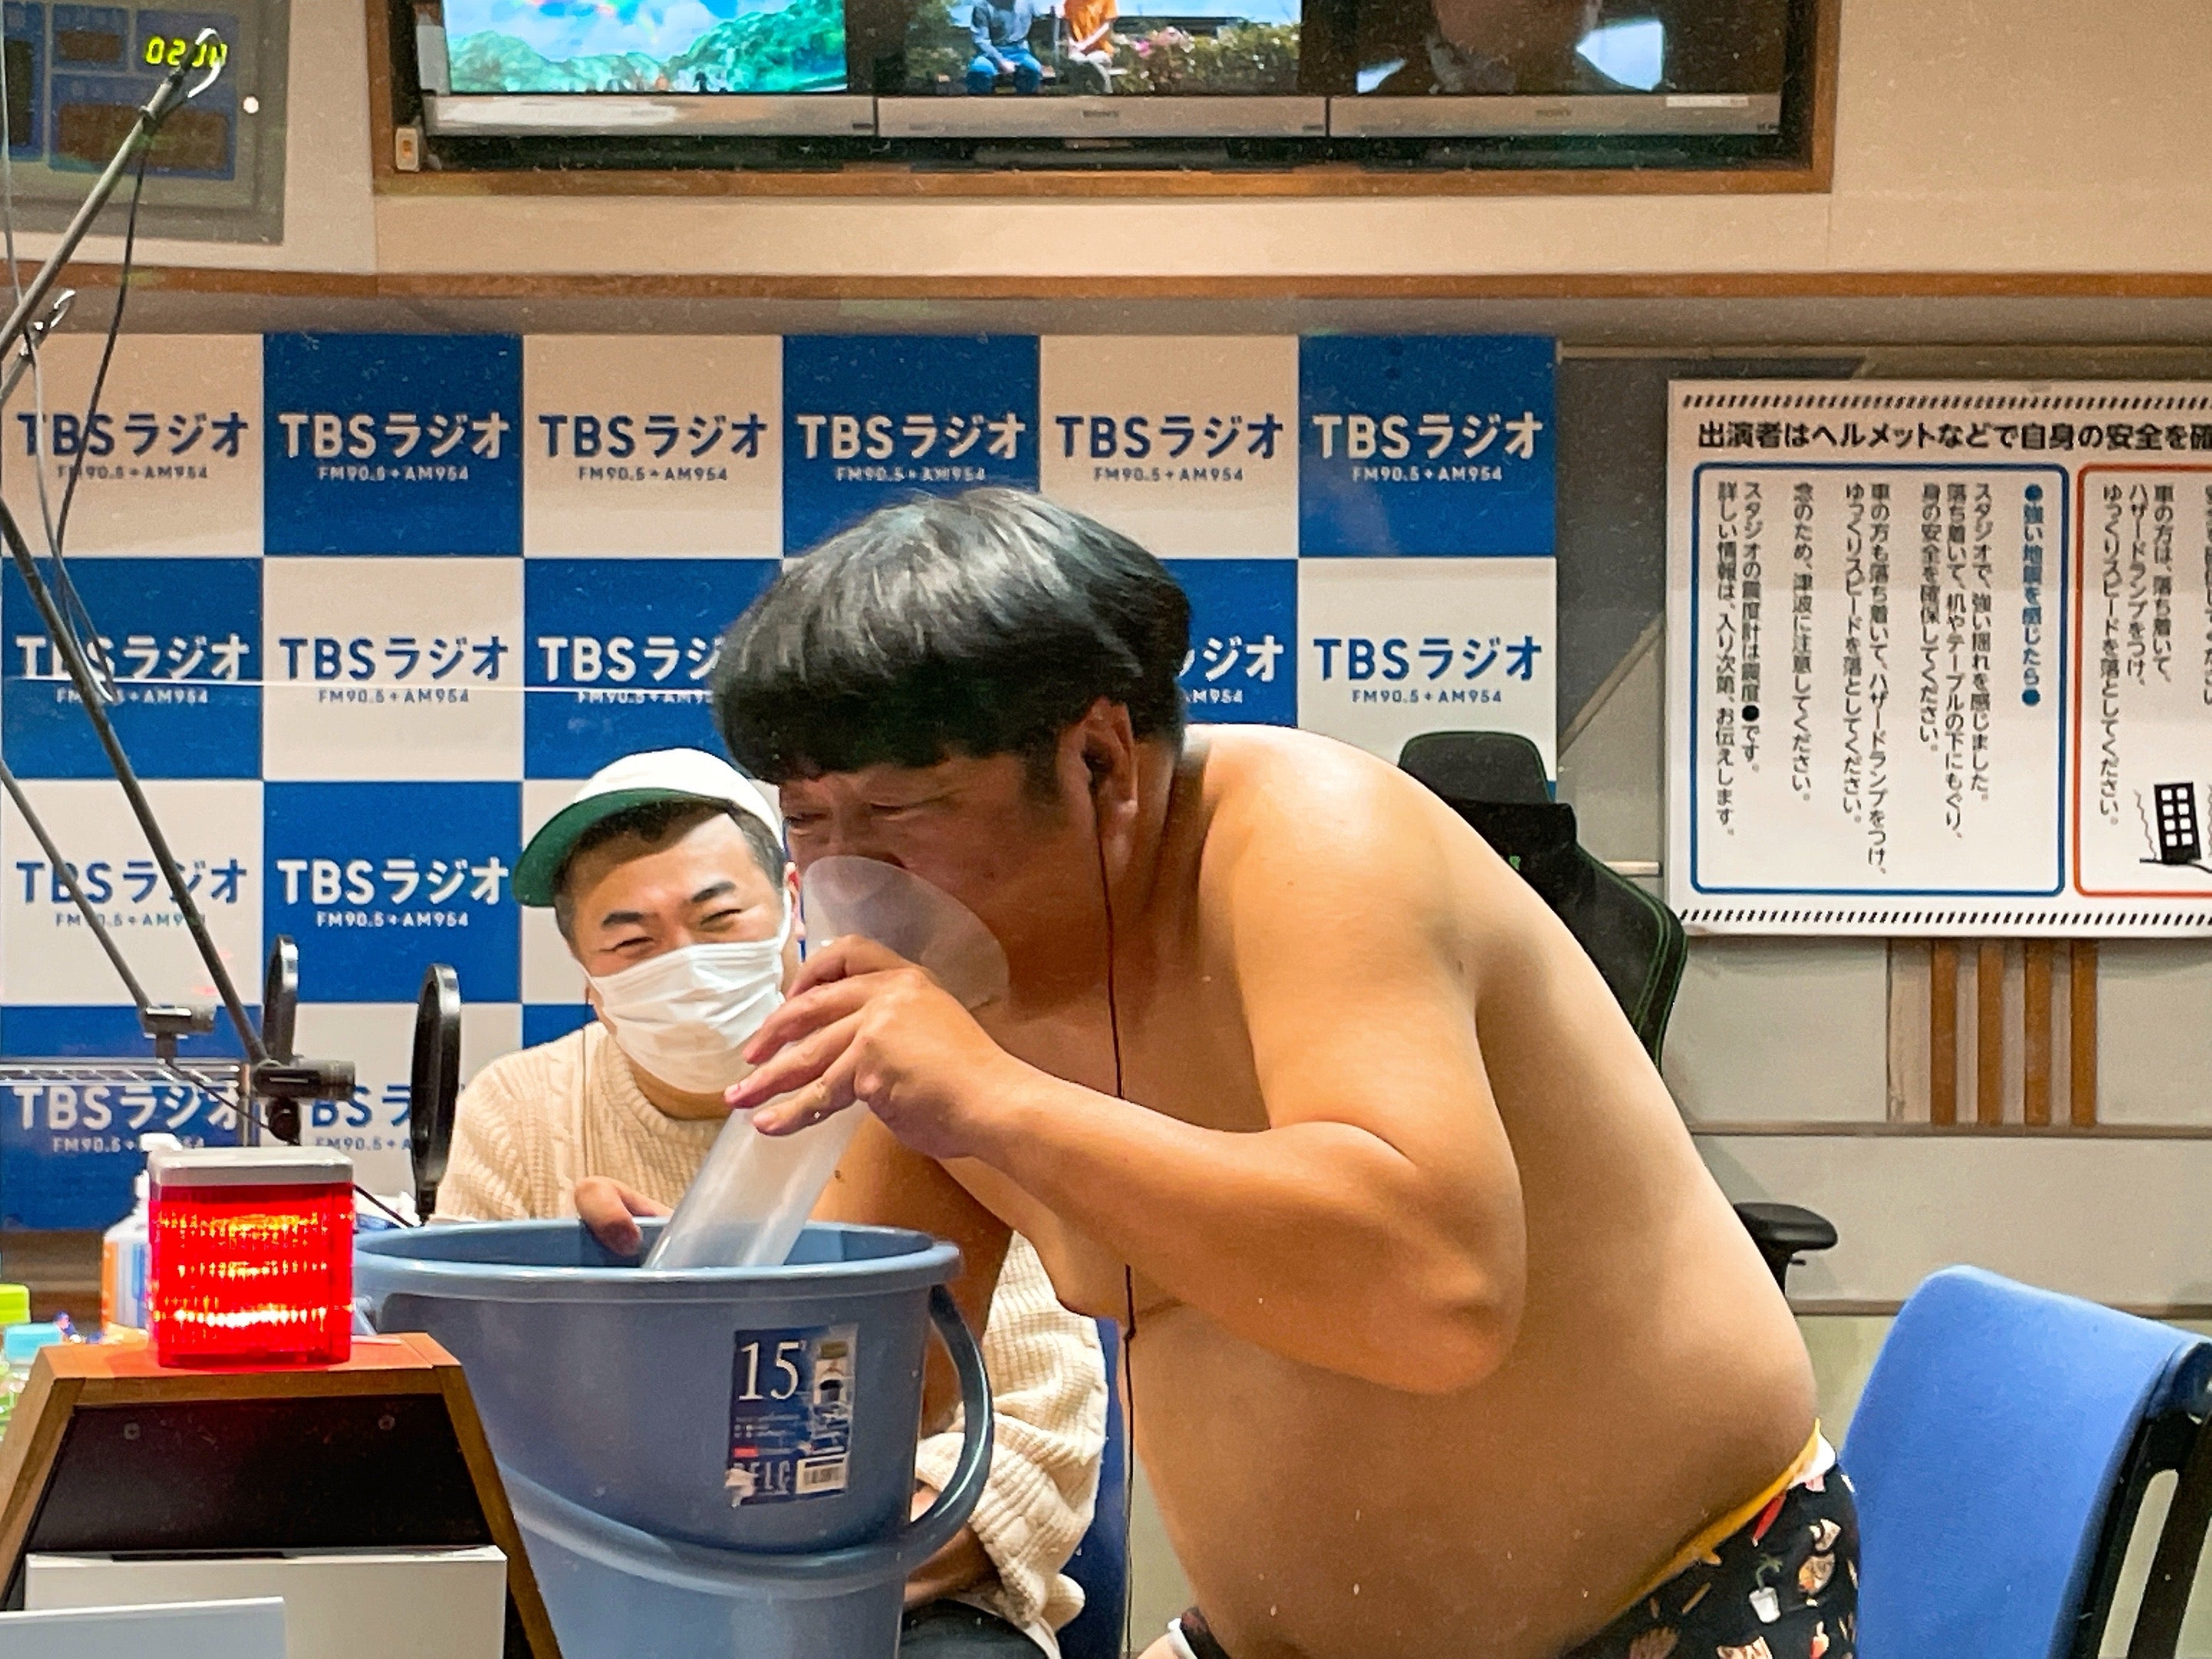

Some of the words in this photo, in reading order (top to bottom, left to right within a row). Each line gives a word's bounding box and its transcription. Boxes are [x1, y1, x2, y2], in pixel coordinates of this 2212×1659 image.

[278, 411, 511, 459] TBSラジオ
[539, 412, 767, 459] TBSラジオ
[795, 412, 1025, 460] TBSラジオ
[1055, 412, 1283, 460] TBSラジオ
[1313, 412, 1542, 459] TBSラジオ
[279, 635, 508, 681] TBSラジオ
[538, 635, 724, 681] TBSラジ
[1313, 634, 1542, 681] TBSラジオ
[276, 856, 509, 905] TBSラジオ
[739, 1341, 801, 1400] 15
